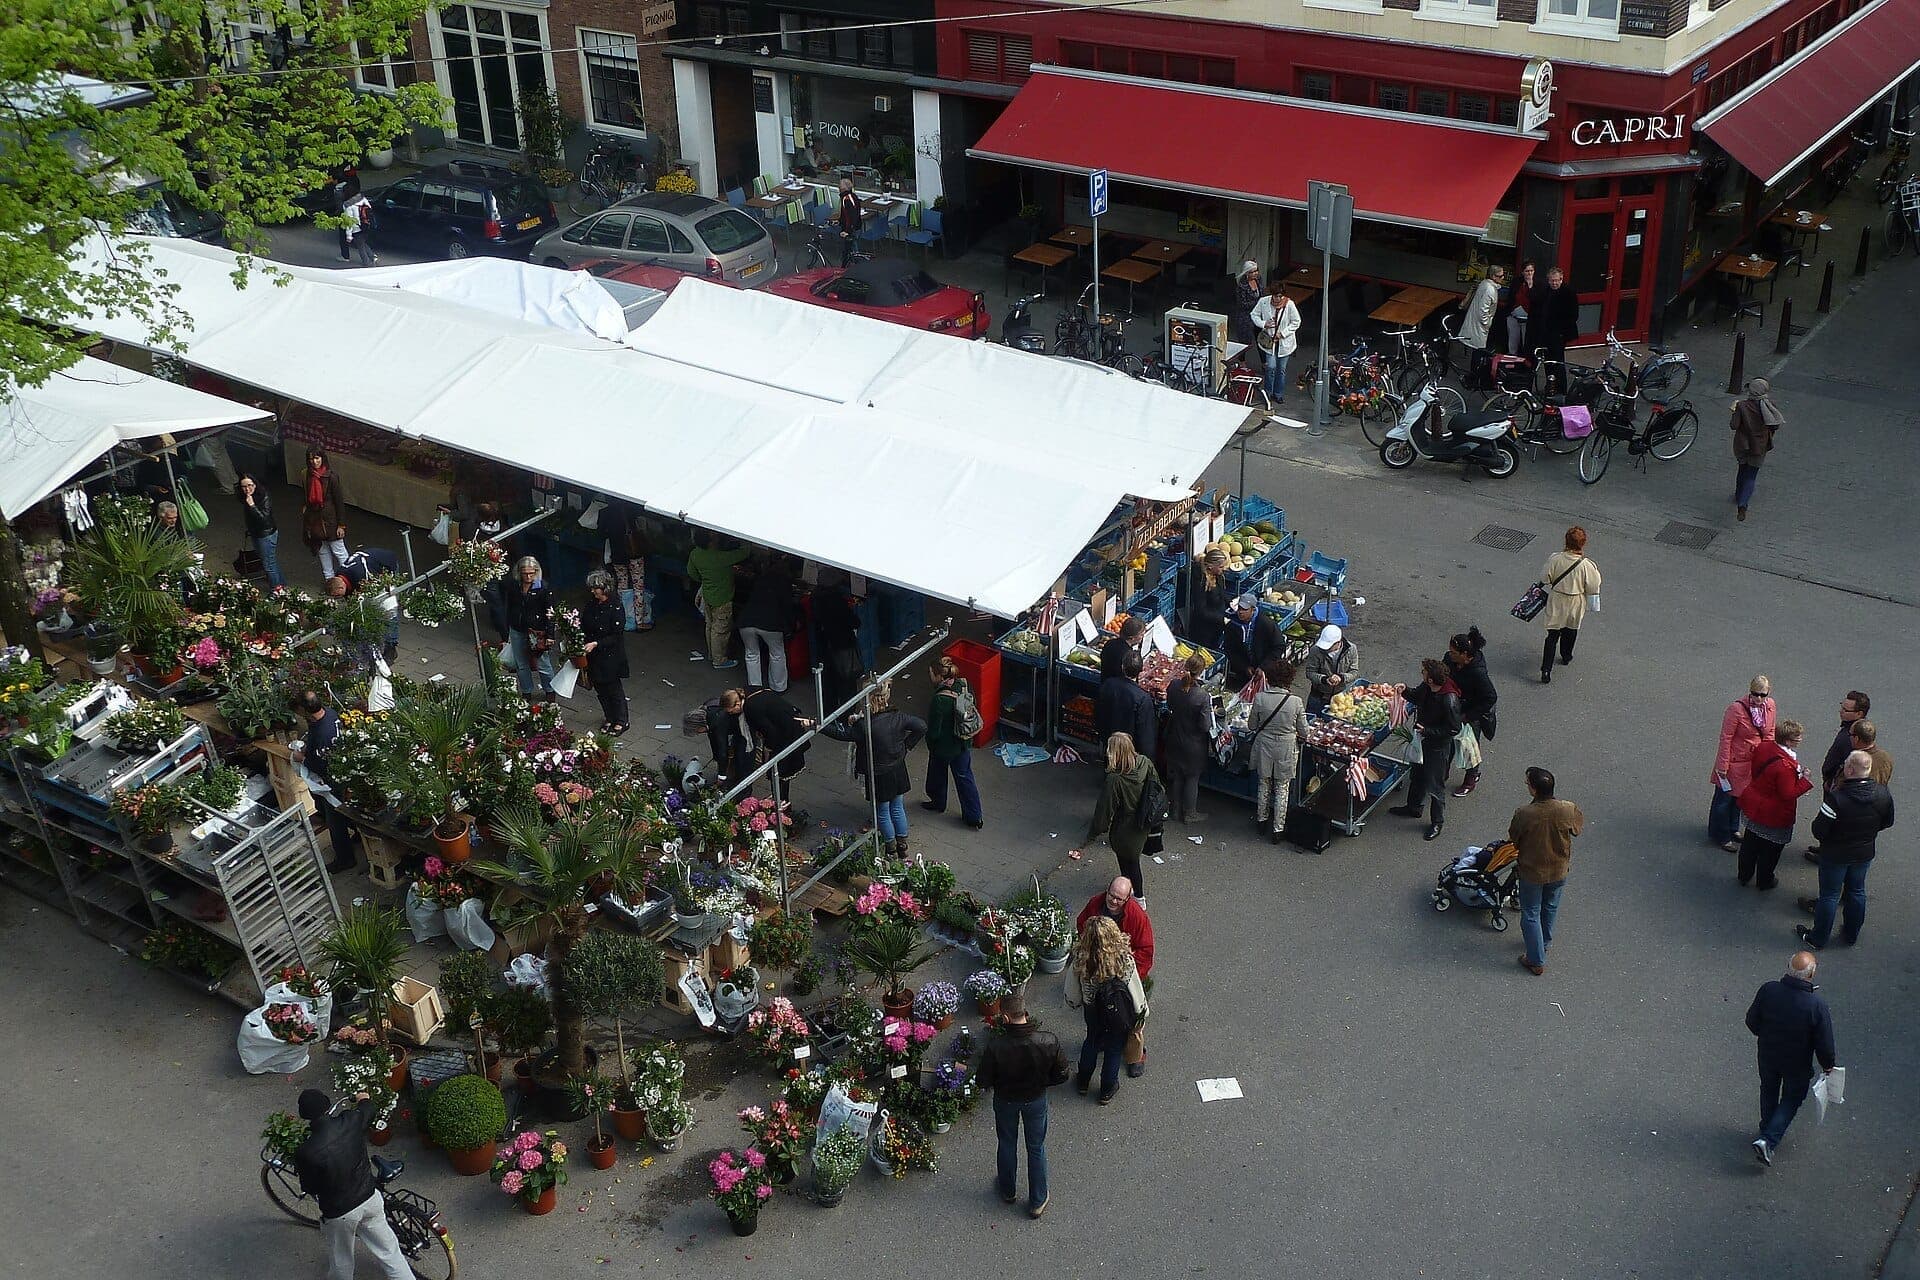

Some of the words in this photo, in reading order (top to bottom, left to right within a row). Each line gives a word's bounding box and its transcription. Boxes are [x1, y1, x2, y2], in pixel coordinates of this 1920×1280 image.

[645, 9, 674, 27] PIQNIQ
[819, 121, 860, 141] PIQNIQ
[1571, 114, 1685, 145] CAPRI
[1094, 174, 1103, 198] P
[1137, 496, 1197, 549] ZELFBEDIENIN
